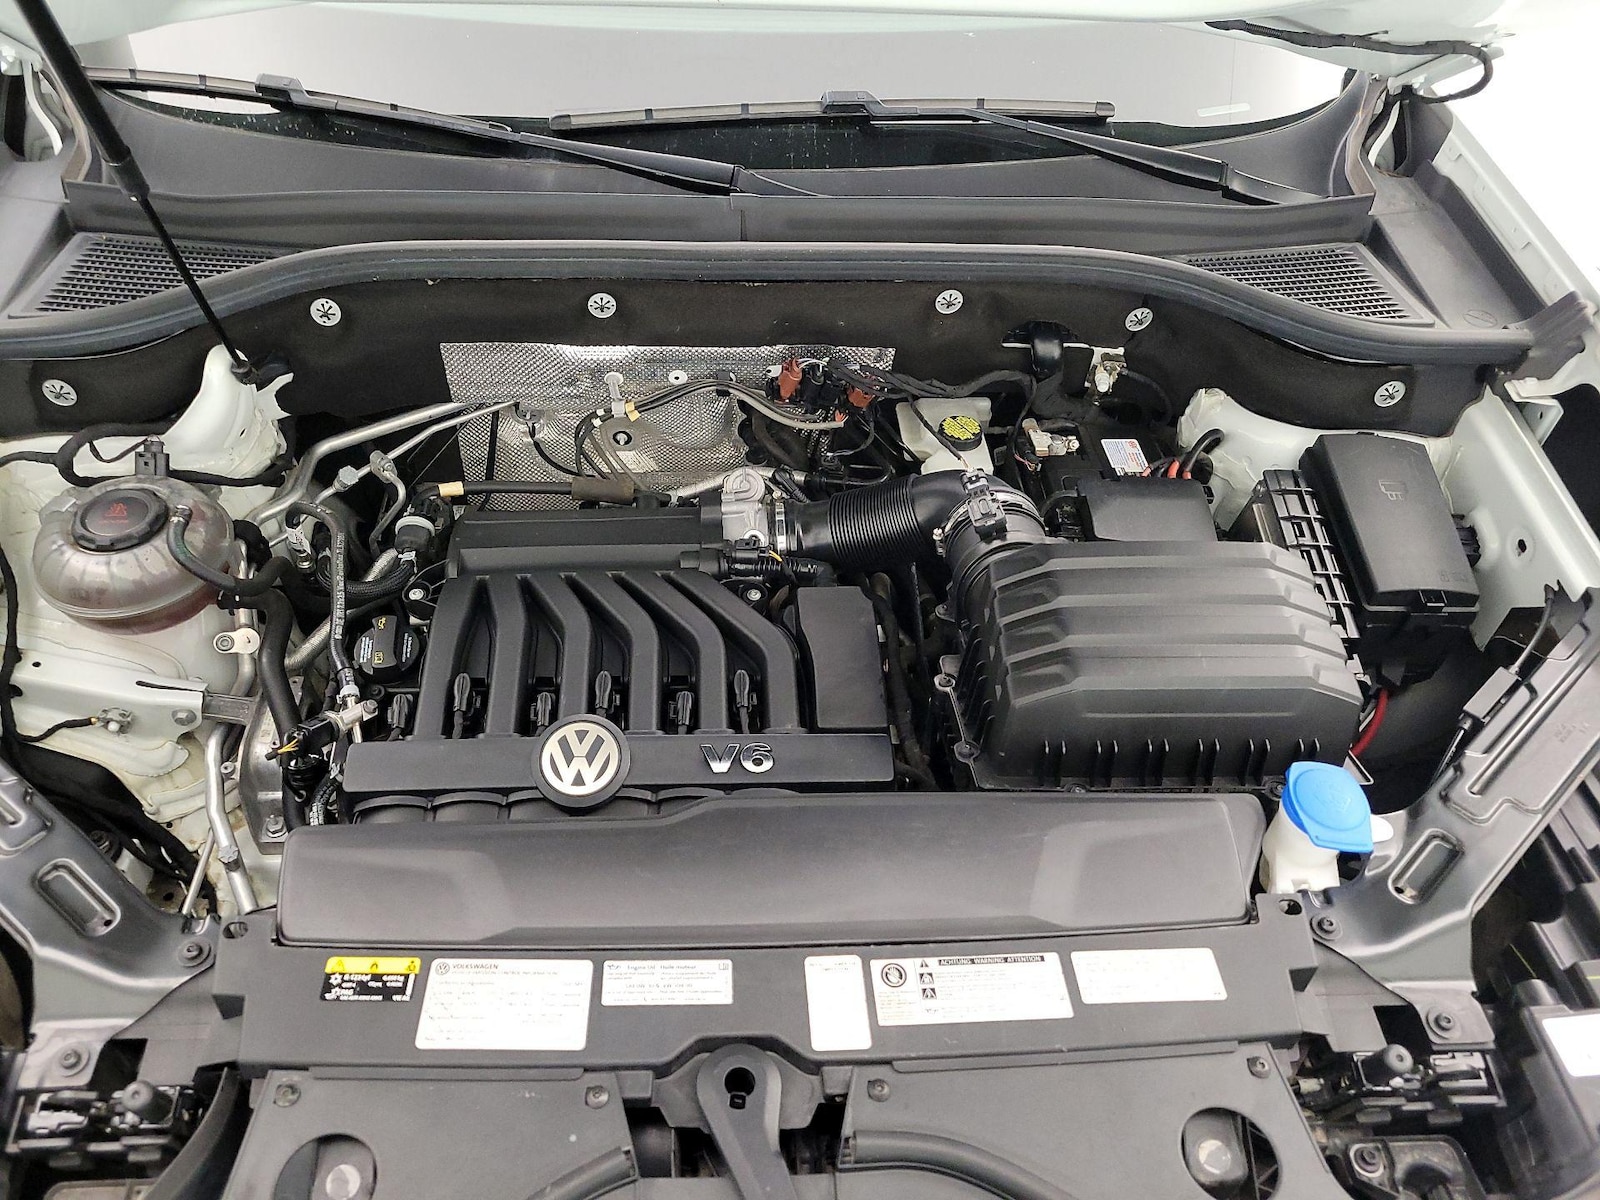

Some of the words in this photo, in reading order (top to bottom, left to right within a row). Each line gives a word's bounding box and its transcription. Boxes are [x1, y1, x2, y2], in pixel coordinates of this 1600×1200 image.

[541, 721, 619, 796] VW
[700, 742, 775, 773] V6
[1007, 955, 1041, 963] ATTENTION
